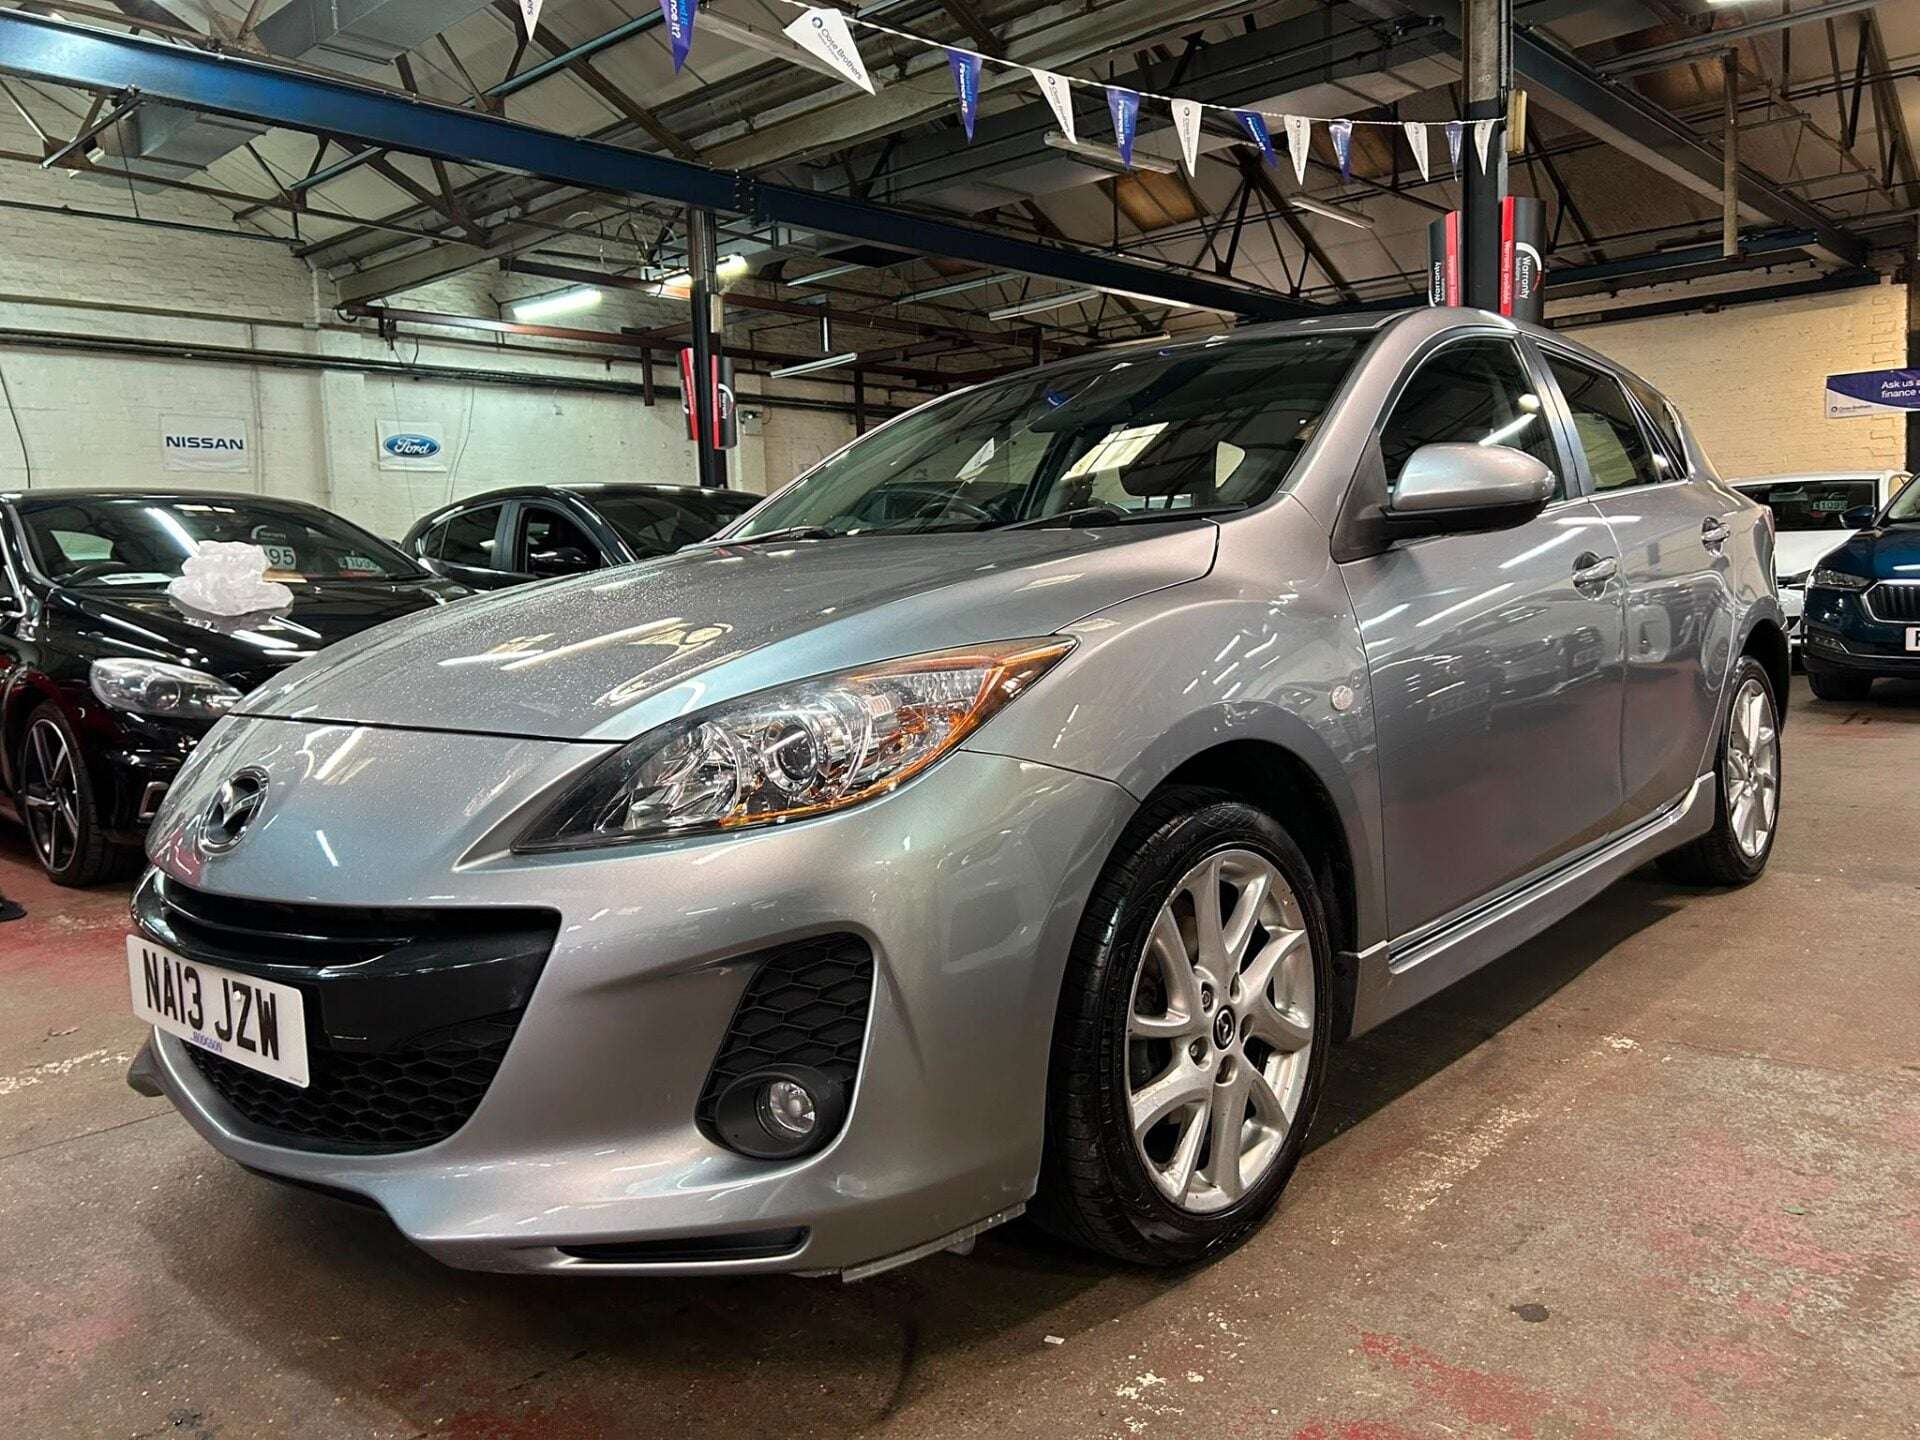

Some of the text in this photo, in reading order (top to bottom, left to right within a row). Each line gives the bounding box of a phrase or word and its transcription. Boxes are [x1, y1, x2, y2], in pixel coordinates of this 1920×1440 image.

[821, 28, 839, 50] Close
[837, 48, 863, 80] Brothers
[1434, 261, 1442, 303] Warranty
[1521, 255, 1530, 299] Warranty
[1881, 380, 1900, 389] Ask
[1902, 380, 1914, 388] us
[1881, 389, 1917, 398] finance
[165, 435, 244, 451] NISSAN
[394, 436, 431, 455] Ford
[264, 547, 295, 566] 95
[142, 947, 280, 1061] NA13 JZW
